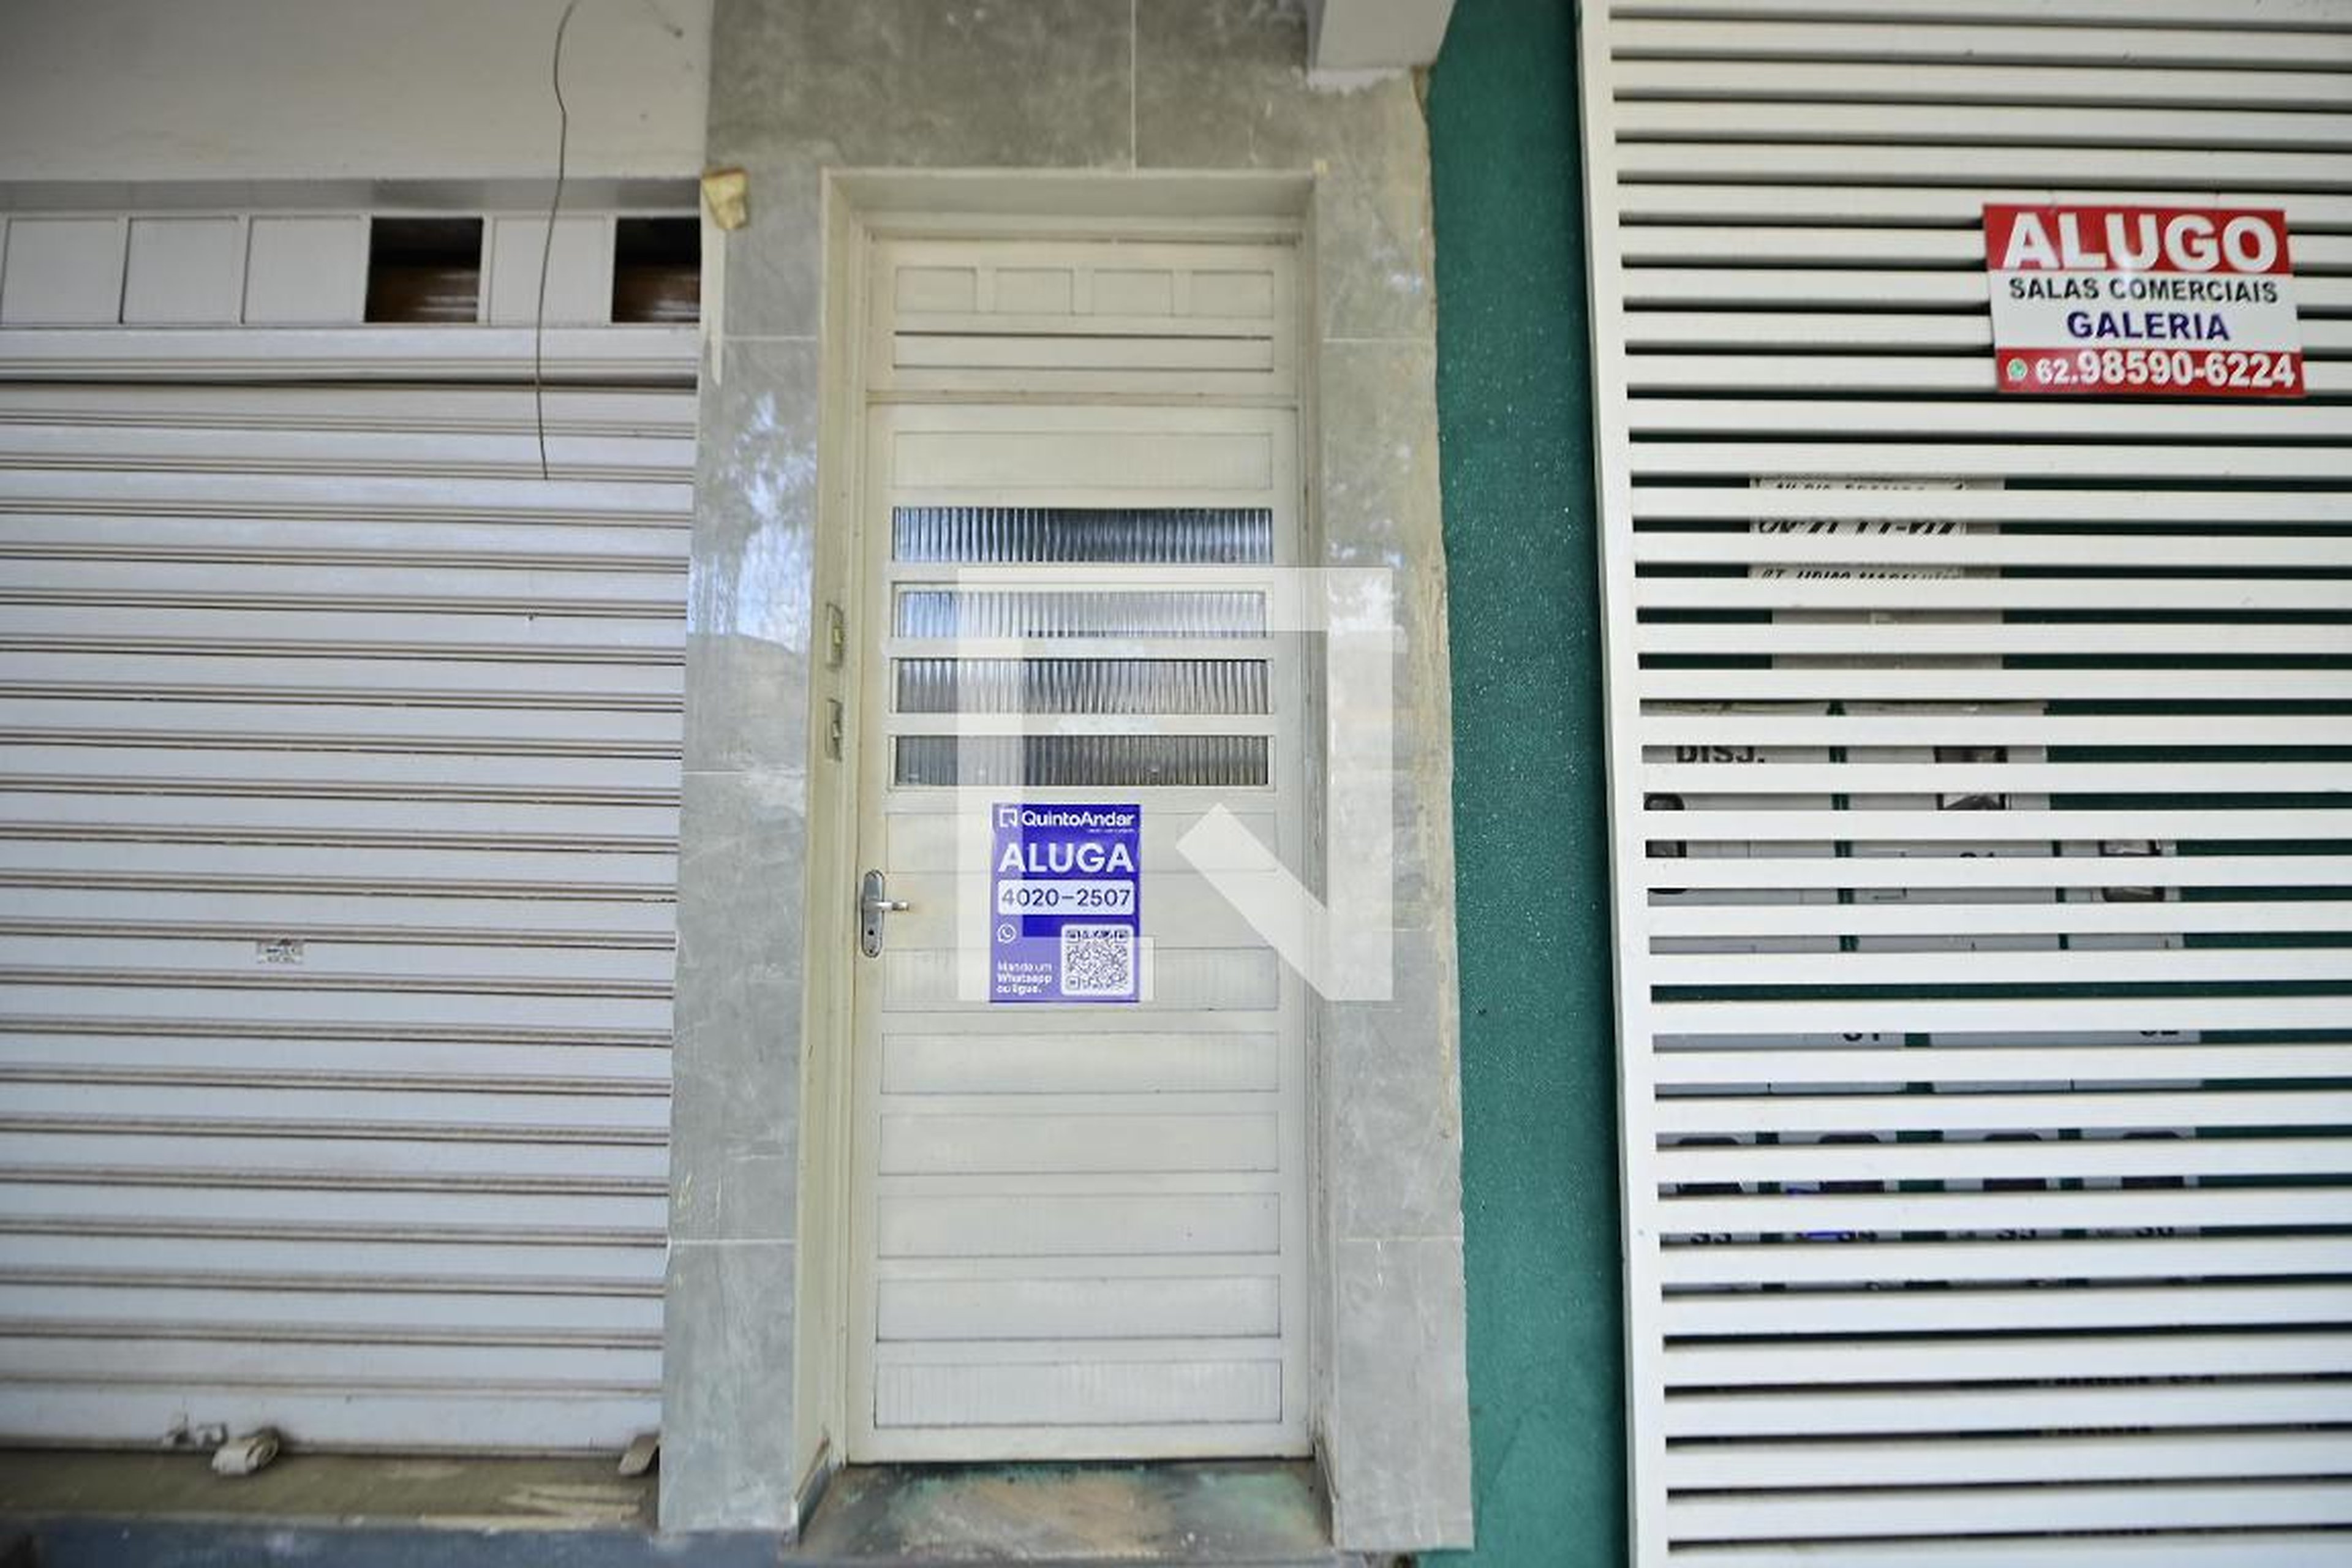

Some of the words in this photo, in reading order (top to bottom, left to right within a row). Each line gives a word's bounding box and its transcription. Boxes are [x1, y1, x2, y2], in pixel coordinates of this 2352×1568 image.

[2002, 212, 2277, 271] ALUGO
[2010, 278, 2099, 300] SALAS
[2109, 279, 2277, 304] COMERCIAIS
[2067, 311, 2231, 341] GALERIA
[2035, 350, 2296, 388] 62.98590-6224
[1022, 810, 1135, 827] QuintoAndar
[998, 843, 1134, 873] ALUGA
[1001, 889, 1131, 907] 4020-2507
